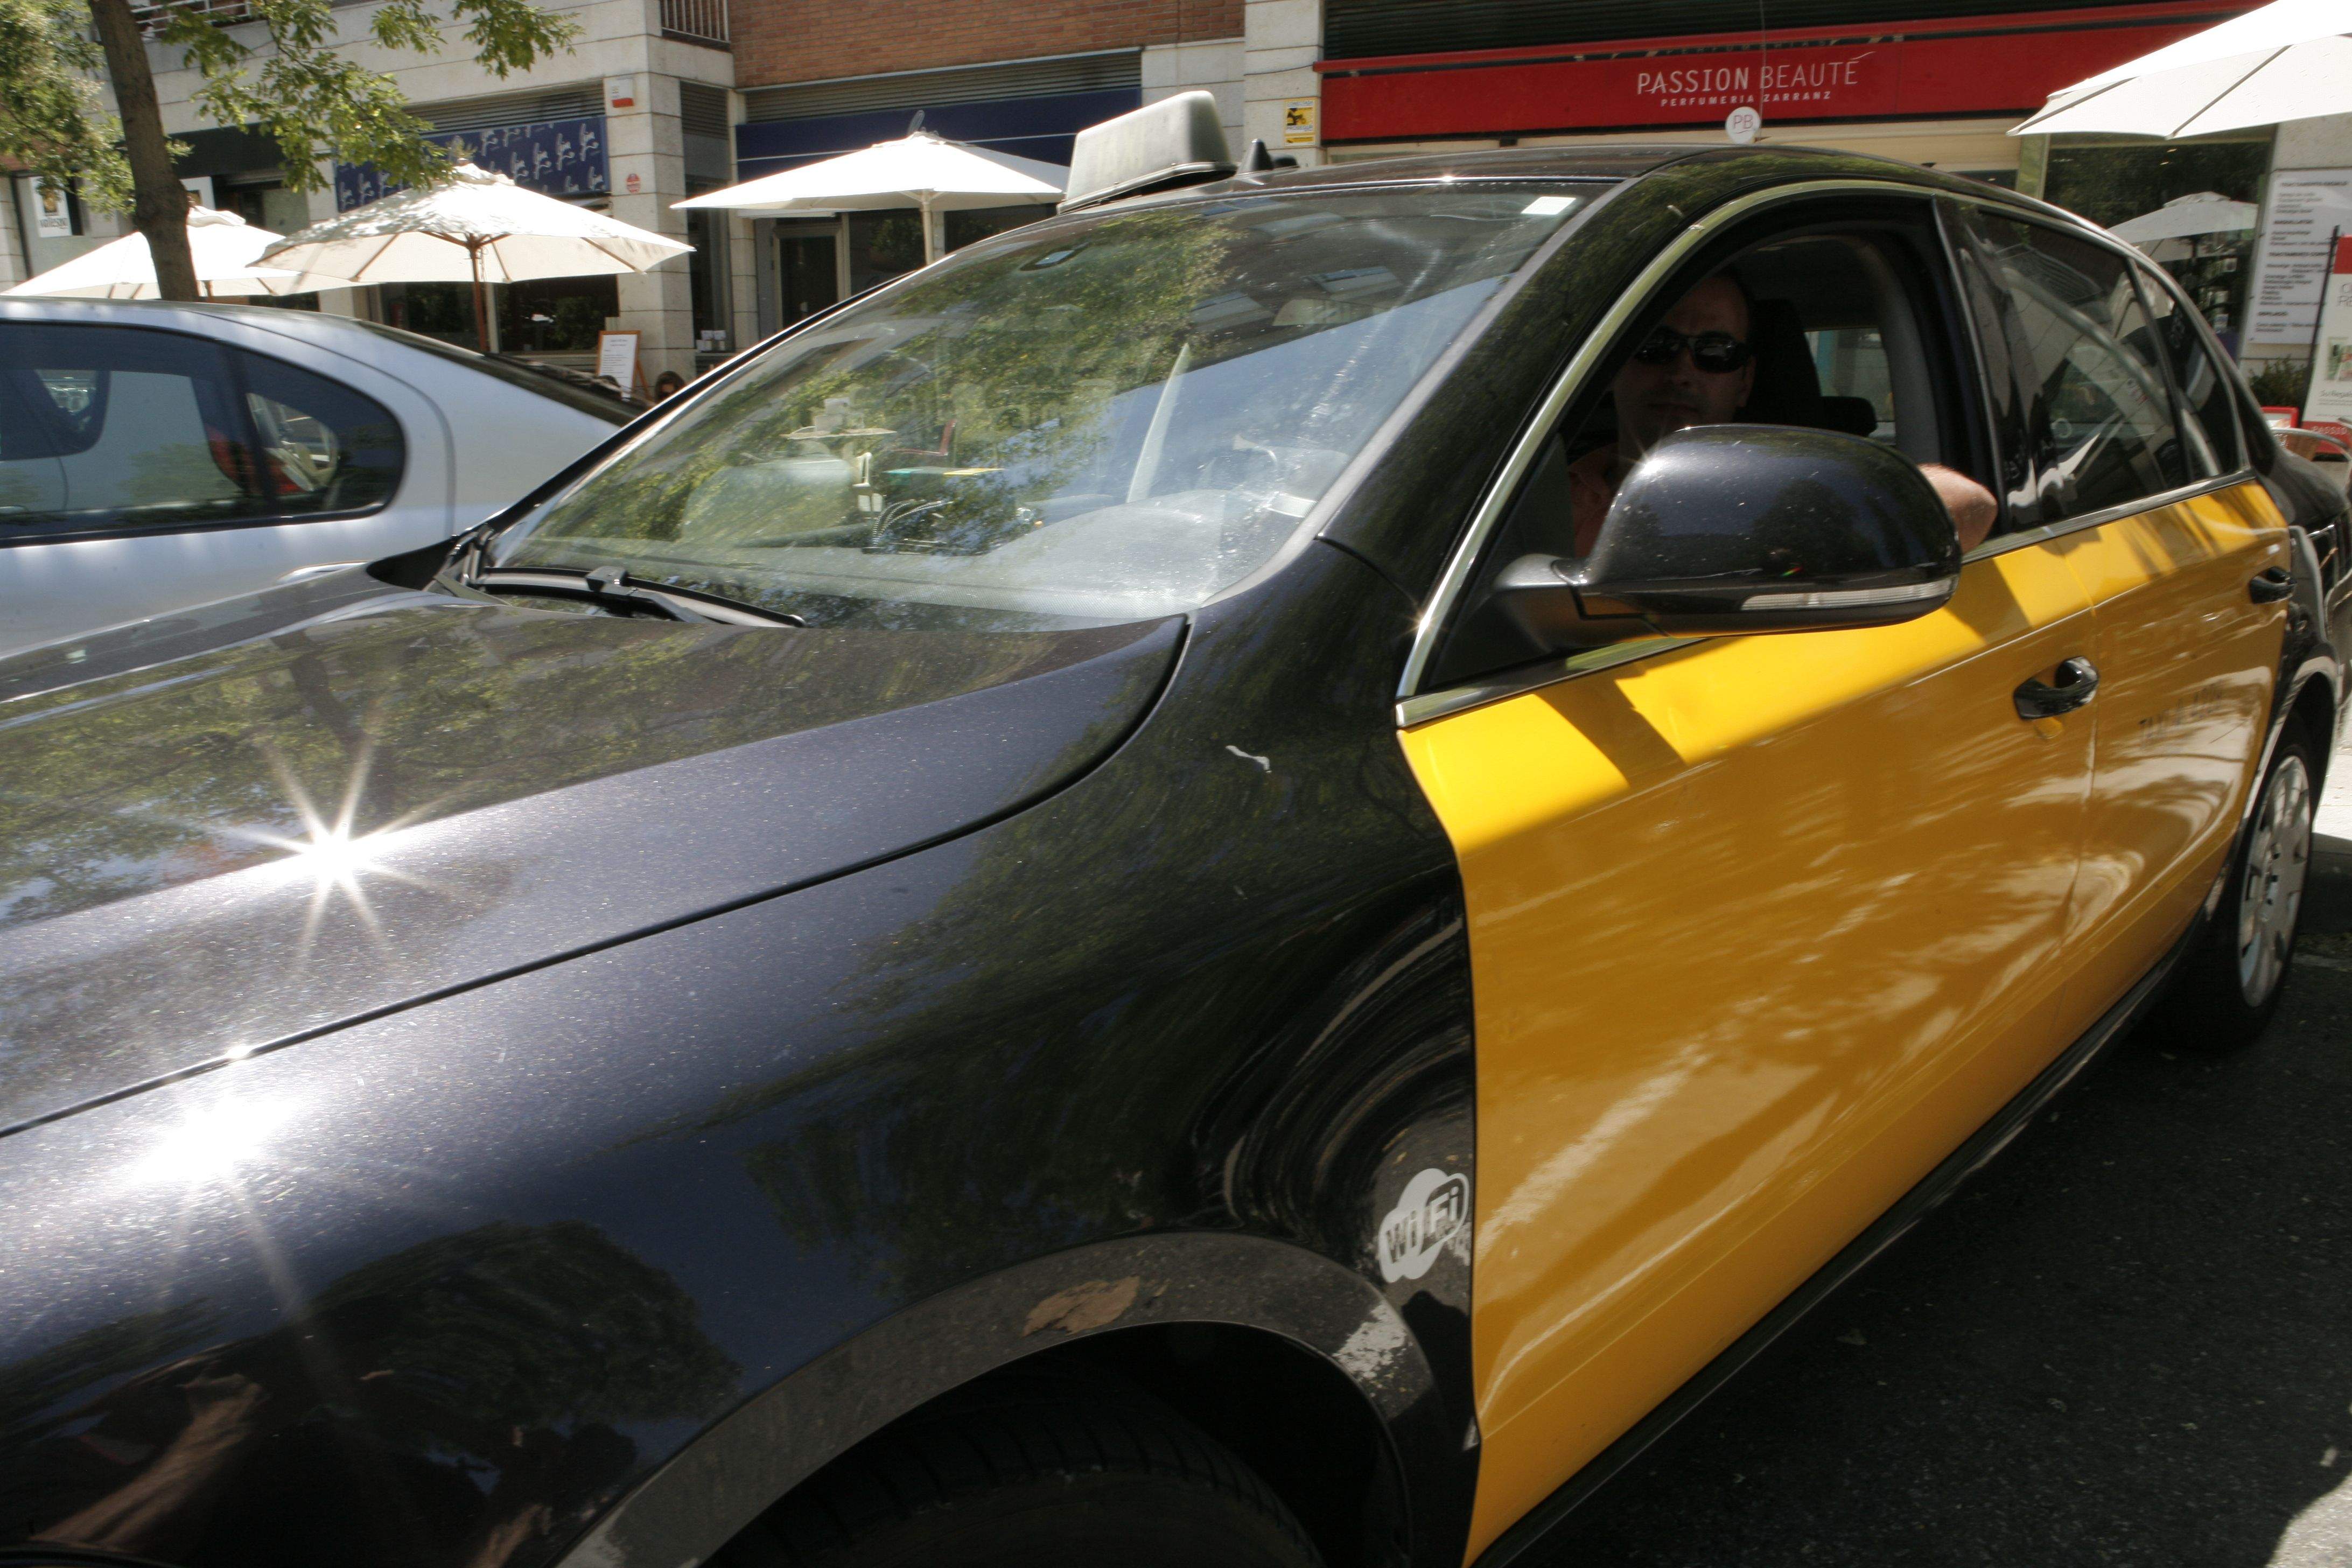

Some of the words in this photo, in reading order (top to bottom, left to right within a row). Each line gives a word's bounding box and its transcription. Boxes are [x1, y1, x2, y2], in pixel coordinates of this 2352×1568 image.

[1637, 67, 1749, 95] PASSION
[1660, 95, 1755, 107] PERFUMERIA
[1762, 91, 1831, 103] ZARRANZ
[1733, 114, 1753, 129] PB
